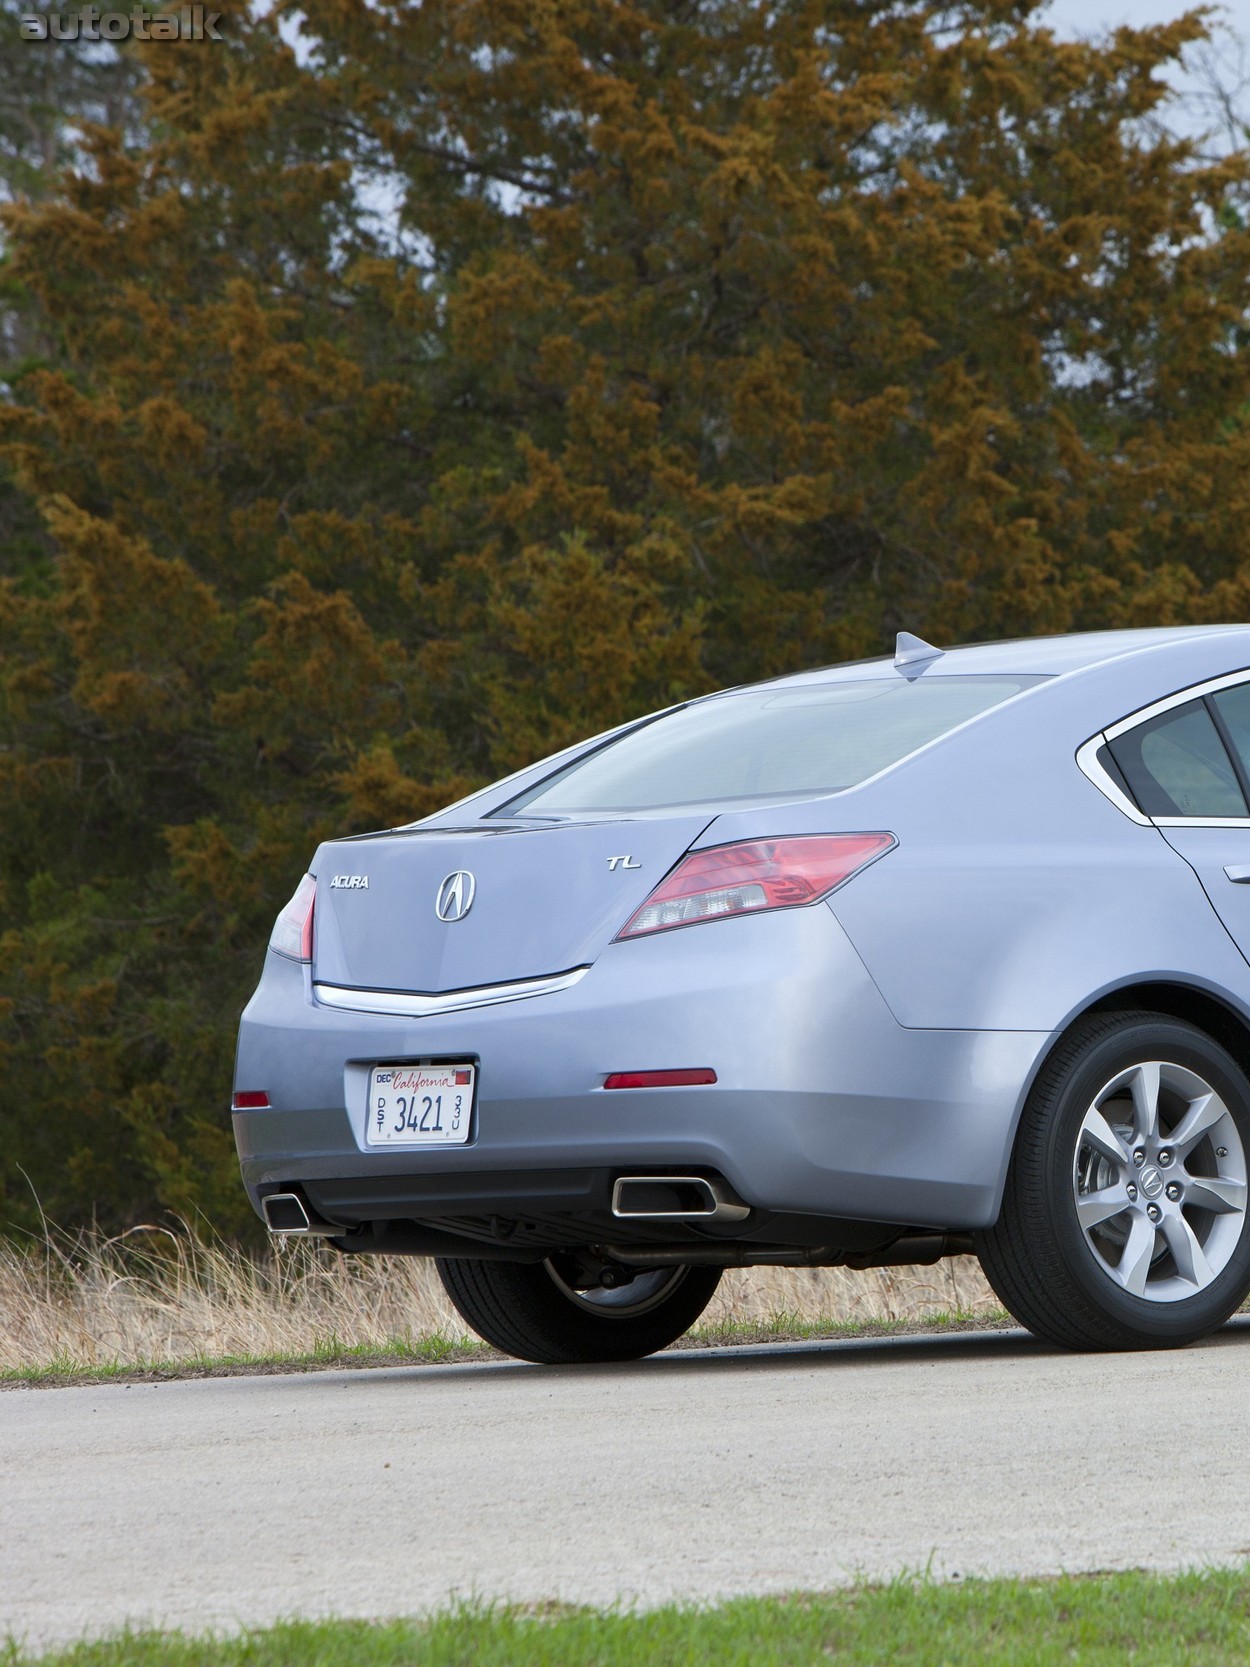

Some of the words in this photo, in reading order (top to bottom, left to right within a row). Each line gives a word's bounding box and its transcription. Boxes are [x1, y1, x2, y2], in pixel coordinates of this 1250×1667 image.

[606, 855, 642, 871] TL
[330, 875, 369, 889] ACURA
[376, 1074, 391, 1083] DEC
[393, 1071, 455, 1094] California
[394, 1095, 443, 1132] 3421
